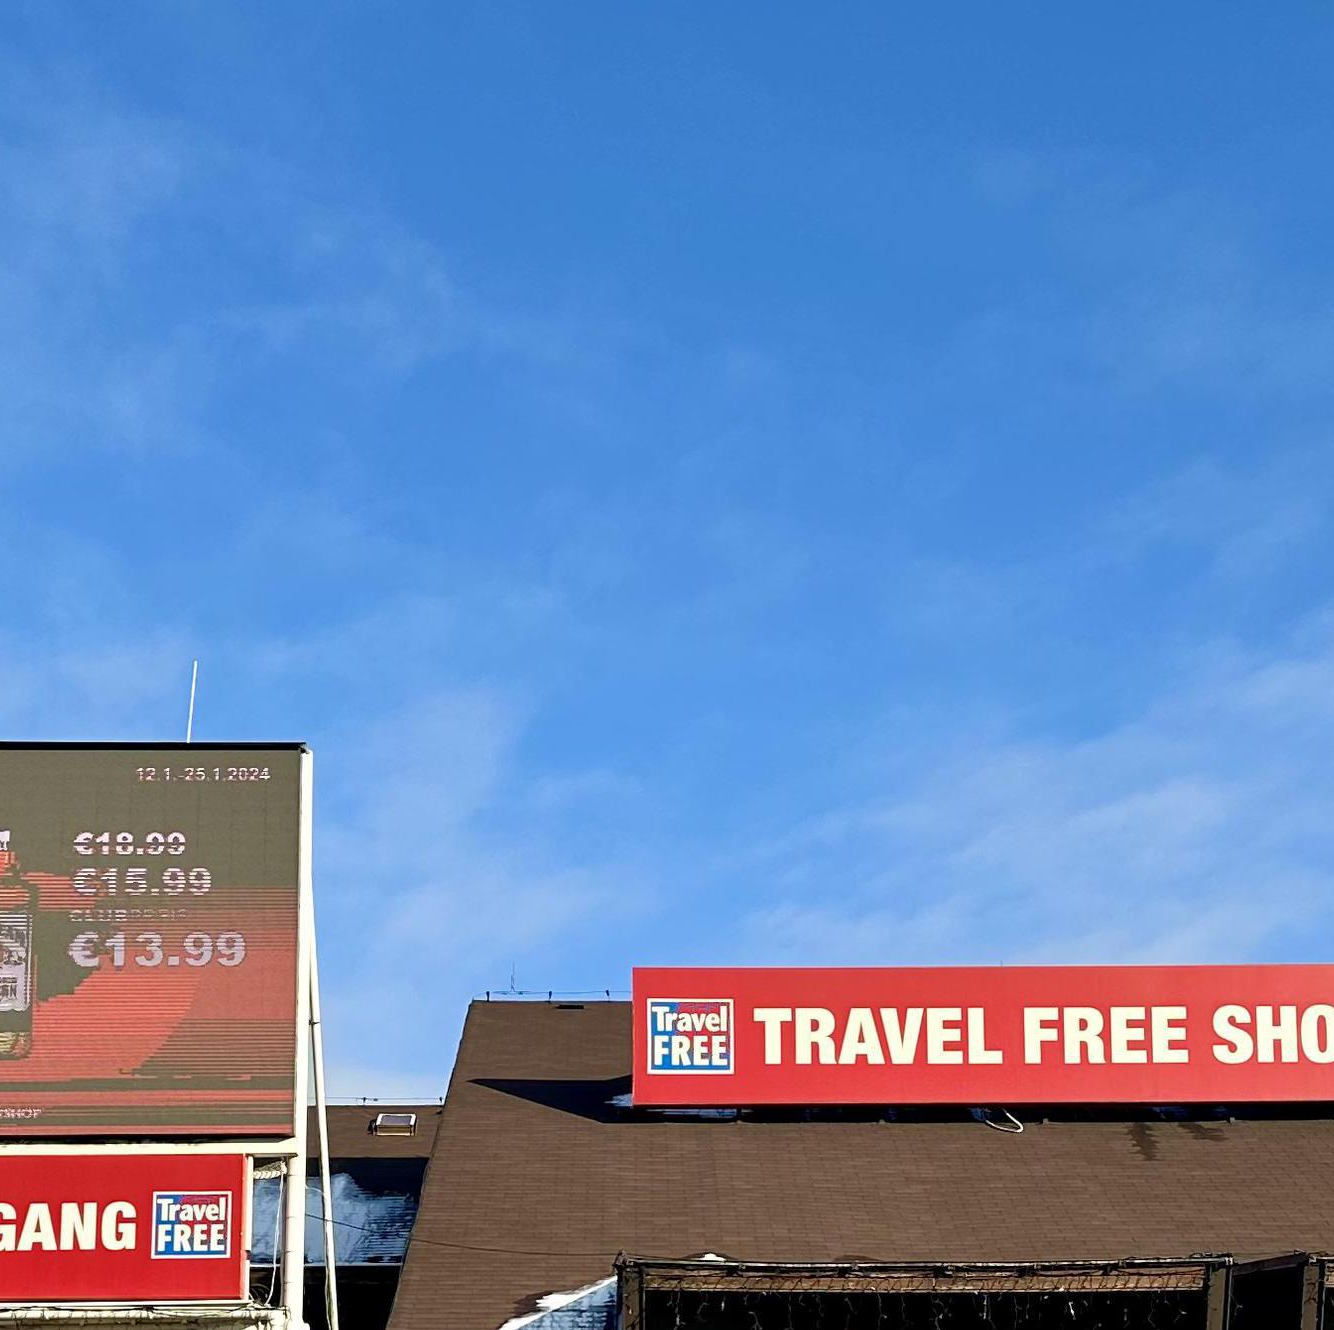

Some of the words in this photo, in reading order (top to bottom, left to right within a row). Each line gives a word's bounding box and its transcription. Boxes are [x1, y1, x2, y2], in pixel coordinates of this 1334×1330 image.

[72, 831, 186, 856] €18.99
[72, 867, 212, 896] €15.99
[67, 929, 247, 968] €13.99
[651, 1005, 728, 1032] Travel
[653, 1034, 728, 1066] FREE
[753, 1006, 1004, 1066] TRAVEL
[1023, 1006, 1190, 1066] FREE
[156, 1197, 226, 1222] Travel
[157, 1223, 226, 1252] FREE
